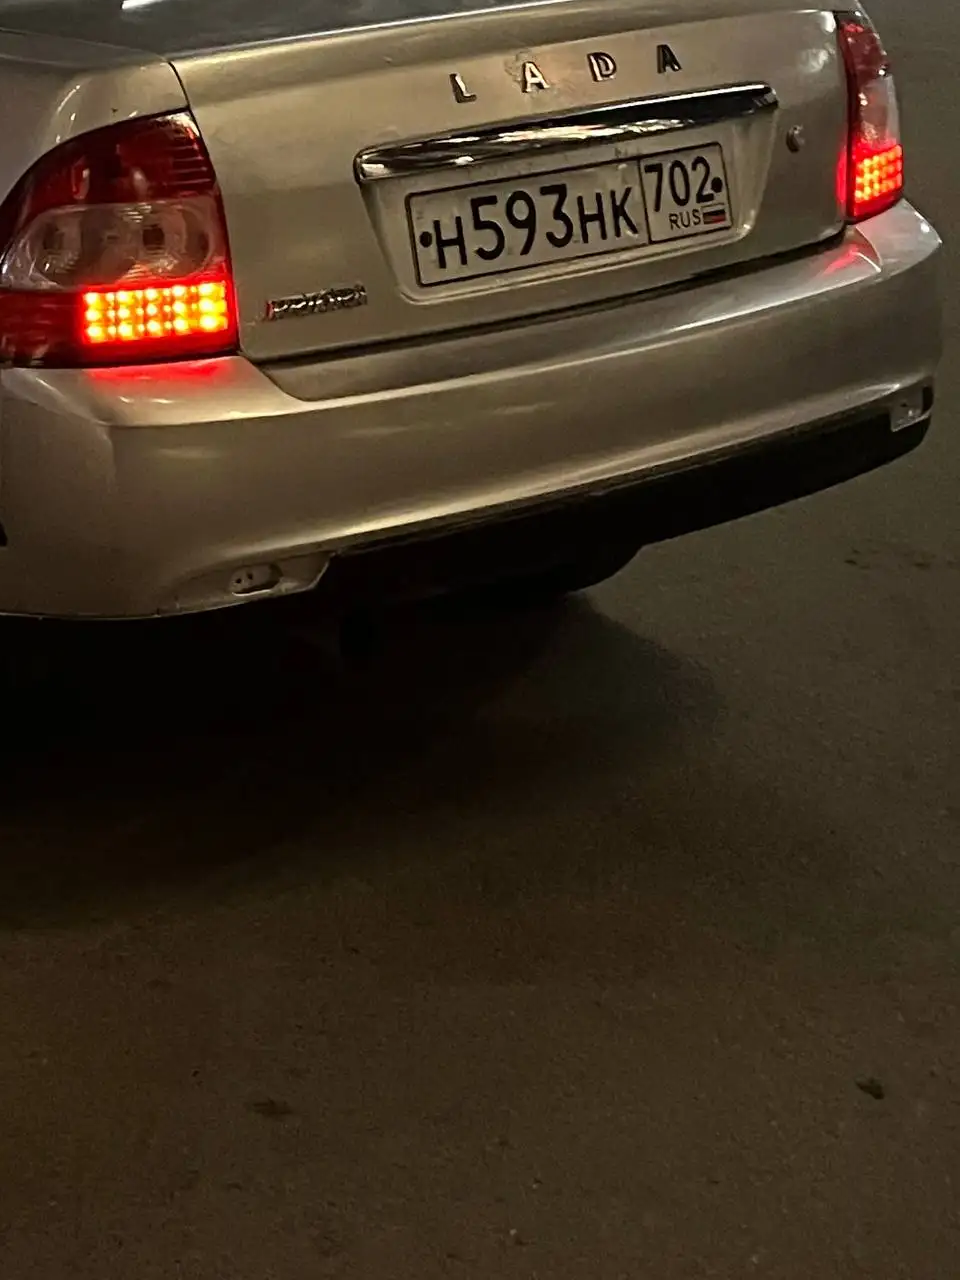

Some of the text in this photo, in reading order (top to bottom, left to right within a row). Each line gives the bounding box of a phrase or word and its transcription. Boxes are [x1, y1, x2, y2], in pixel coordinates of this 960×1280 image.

[449, 44, 682, 104] LADA
[644, 156, 716, 213] 702
[433, 183, 639, 269] Н593НК
[669, 208, 701, 231] RUS
